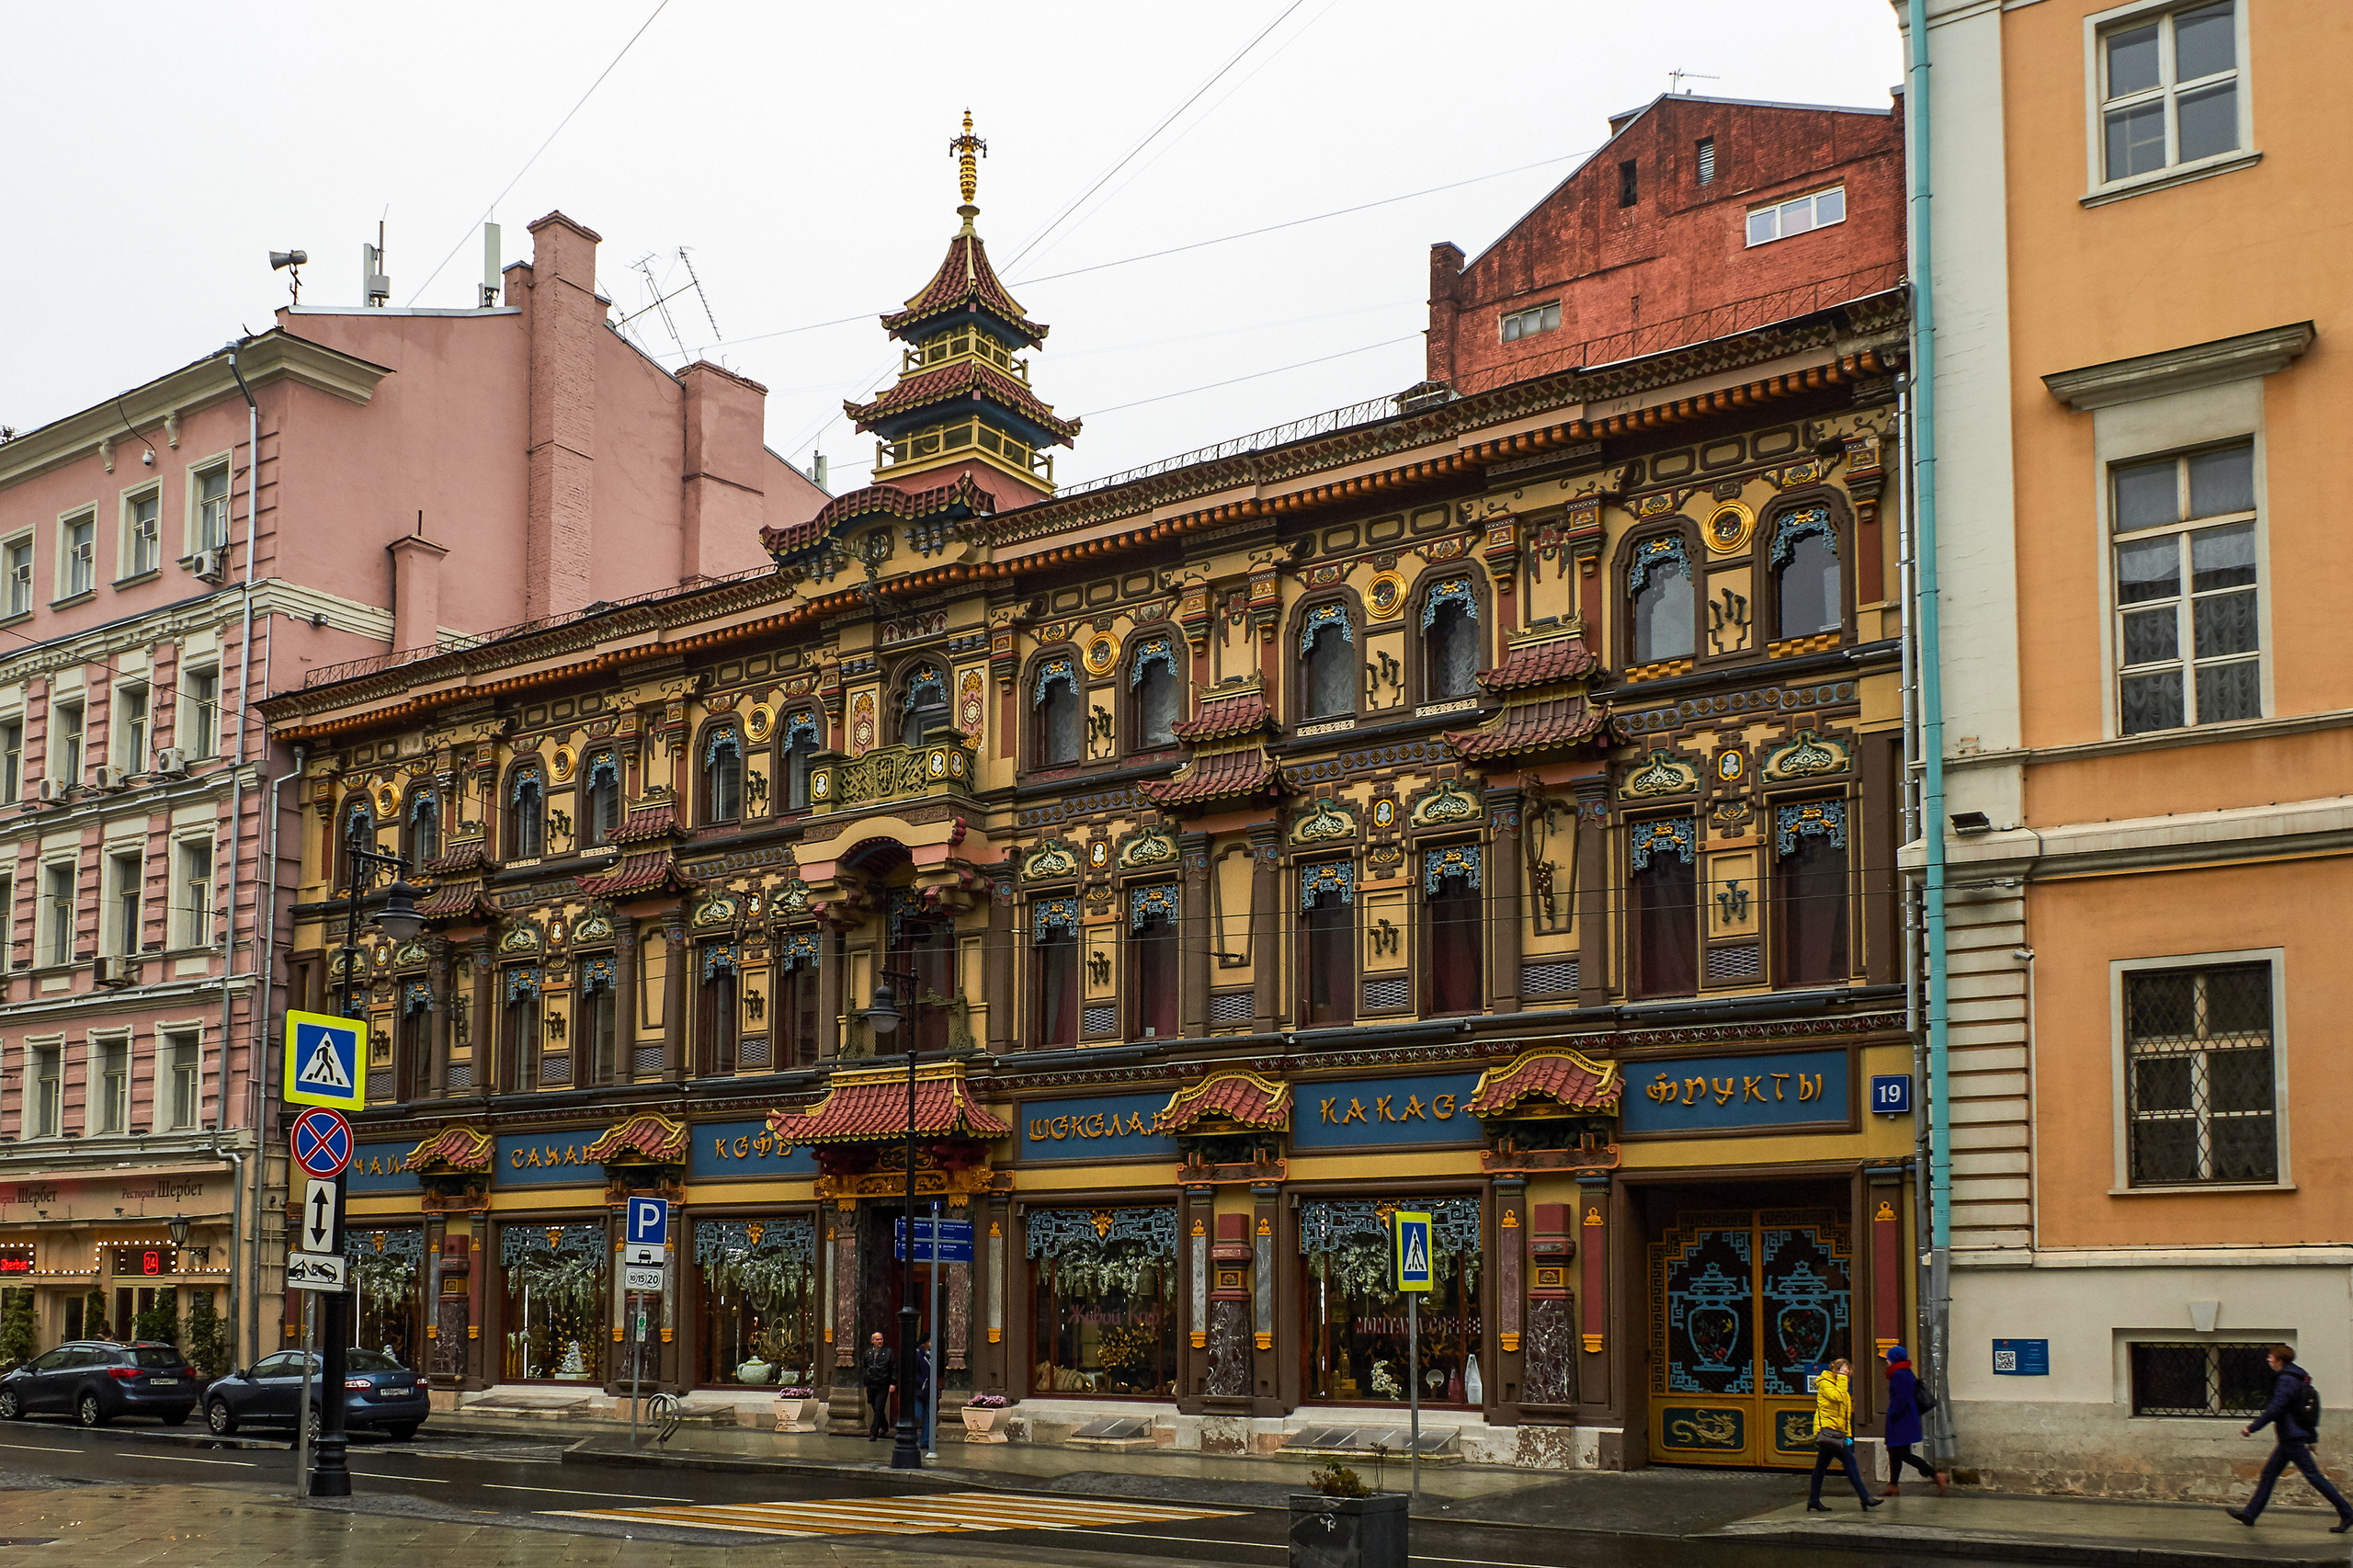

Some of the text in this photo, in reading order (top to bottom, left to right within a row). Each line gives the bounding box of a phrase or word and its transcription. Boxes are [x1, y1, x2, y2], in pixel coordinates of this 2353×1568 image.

[1645, 1072, 1823, 1105] ФРУКТЫ
[1878, 1084, 1902, 1103] 19
[1320, 1094, 1456, 1124] КАКАО
[354, 1153, 401, 1176] ЧАЙ
[17, 1186, 57, 1208] Шербет
[122, 1178, 204, 1202] Ресторан Шербет
[146, 1256, 156, 1269] 24
[638, 1275, 645, 1283] 15
[647, 1274, 659, 1284] 20
[1068, 1304, 1121, 1324] Живой
